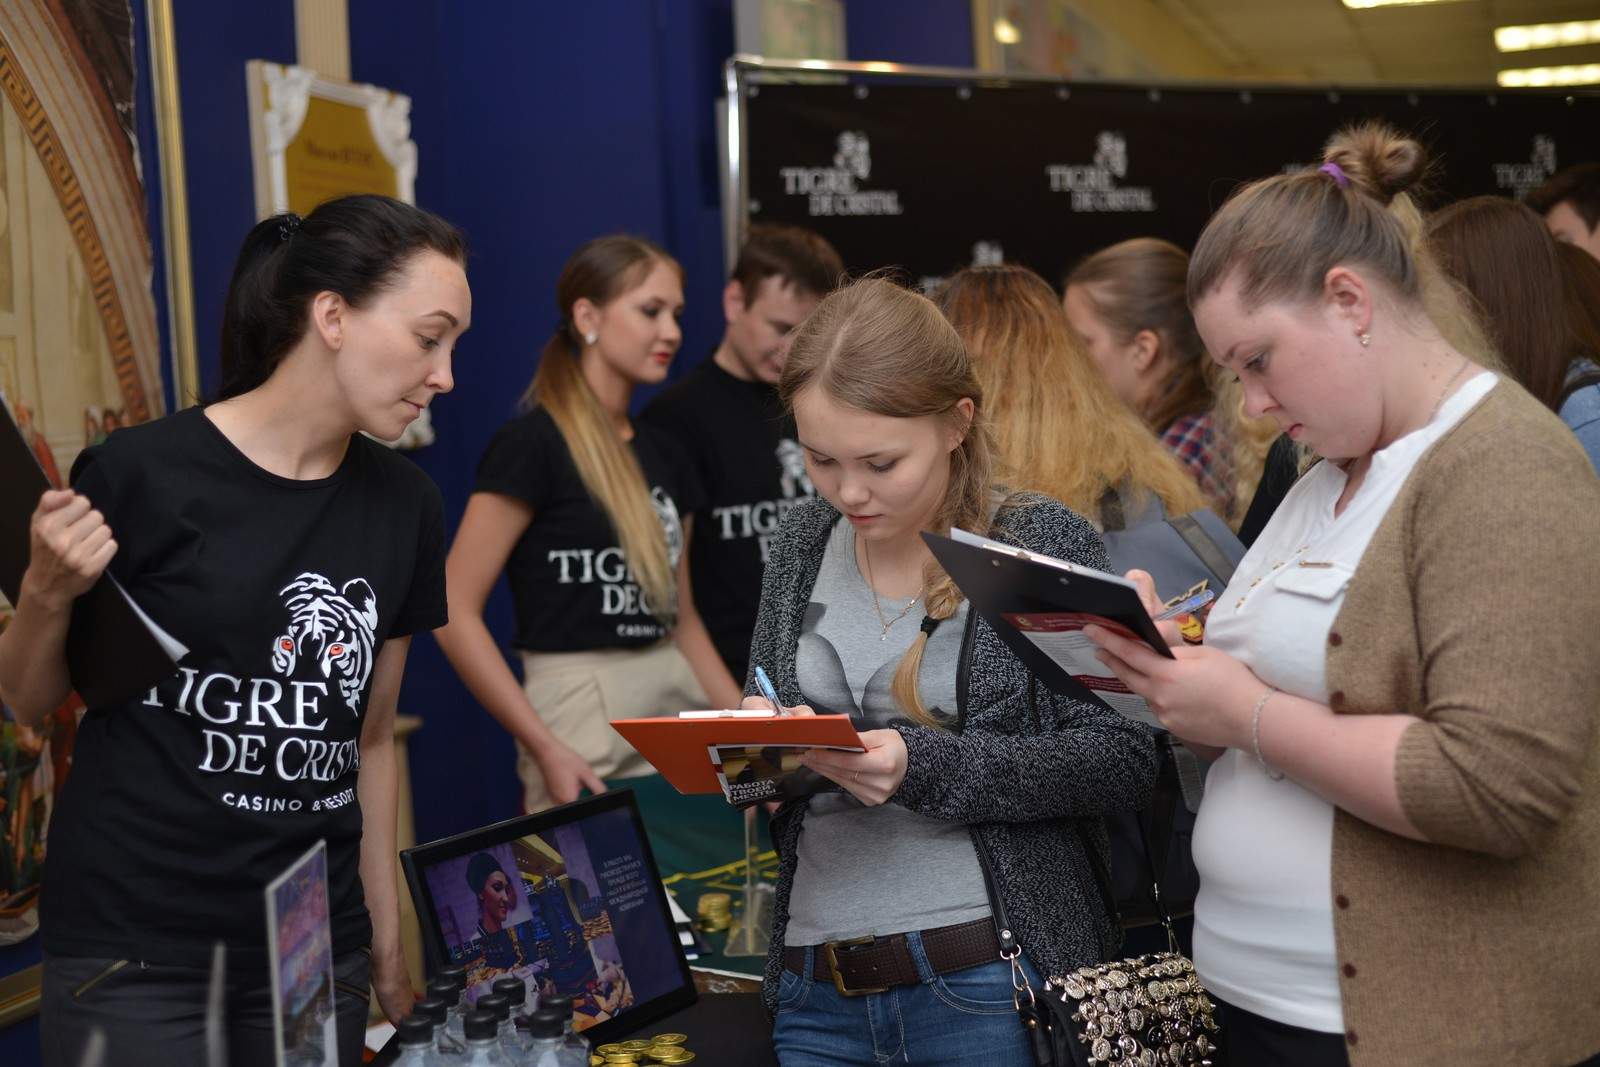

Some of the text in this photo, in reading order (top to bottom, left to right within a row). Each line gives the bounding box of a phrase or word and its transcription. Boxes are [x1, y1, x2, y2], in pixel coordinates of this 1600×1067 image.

[712, 497, 814, 539] TIG
[548, 547, 635, 583] TIG
[198, 729, 359, 781] DE CRISTA
[223, 792, 302, 811] CASINO
[312, 800, 321, 811] &
[729, 779, 775, 790] РАБОТА
